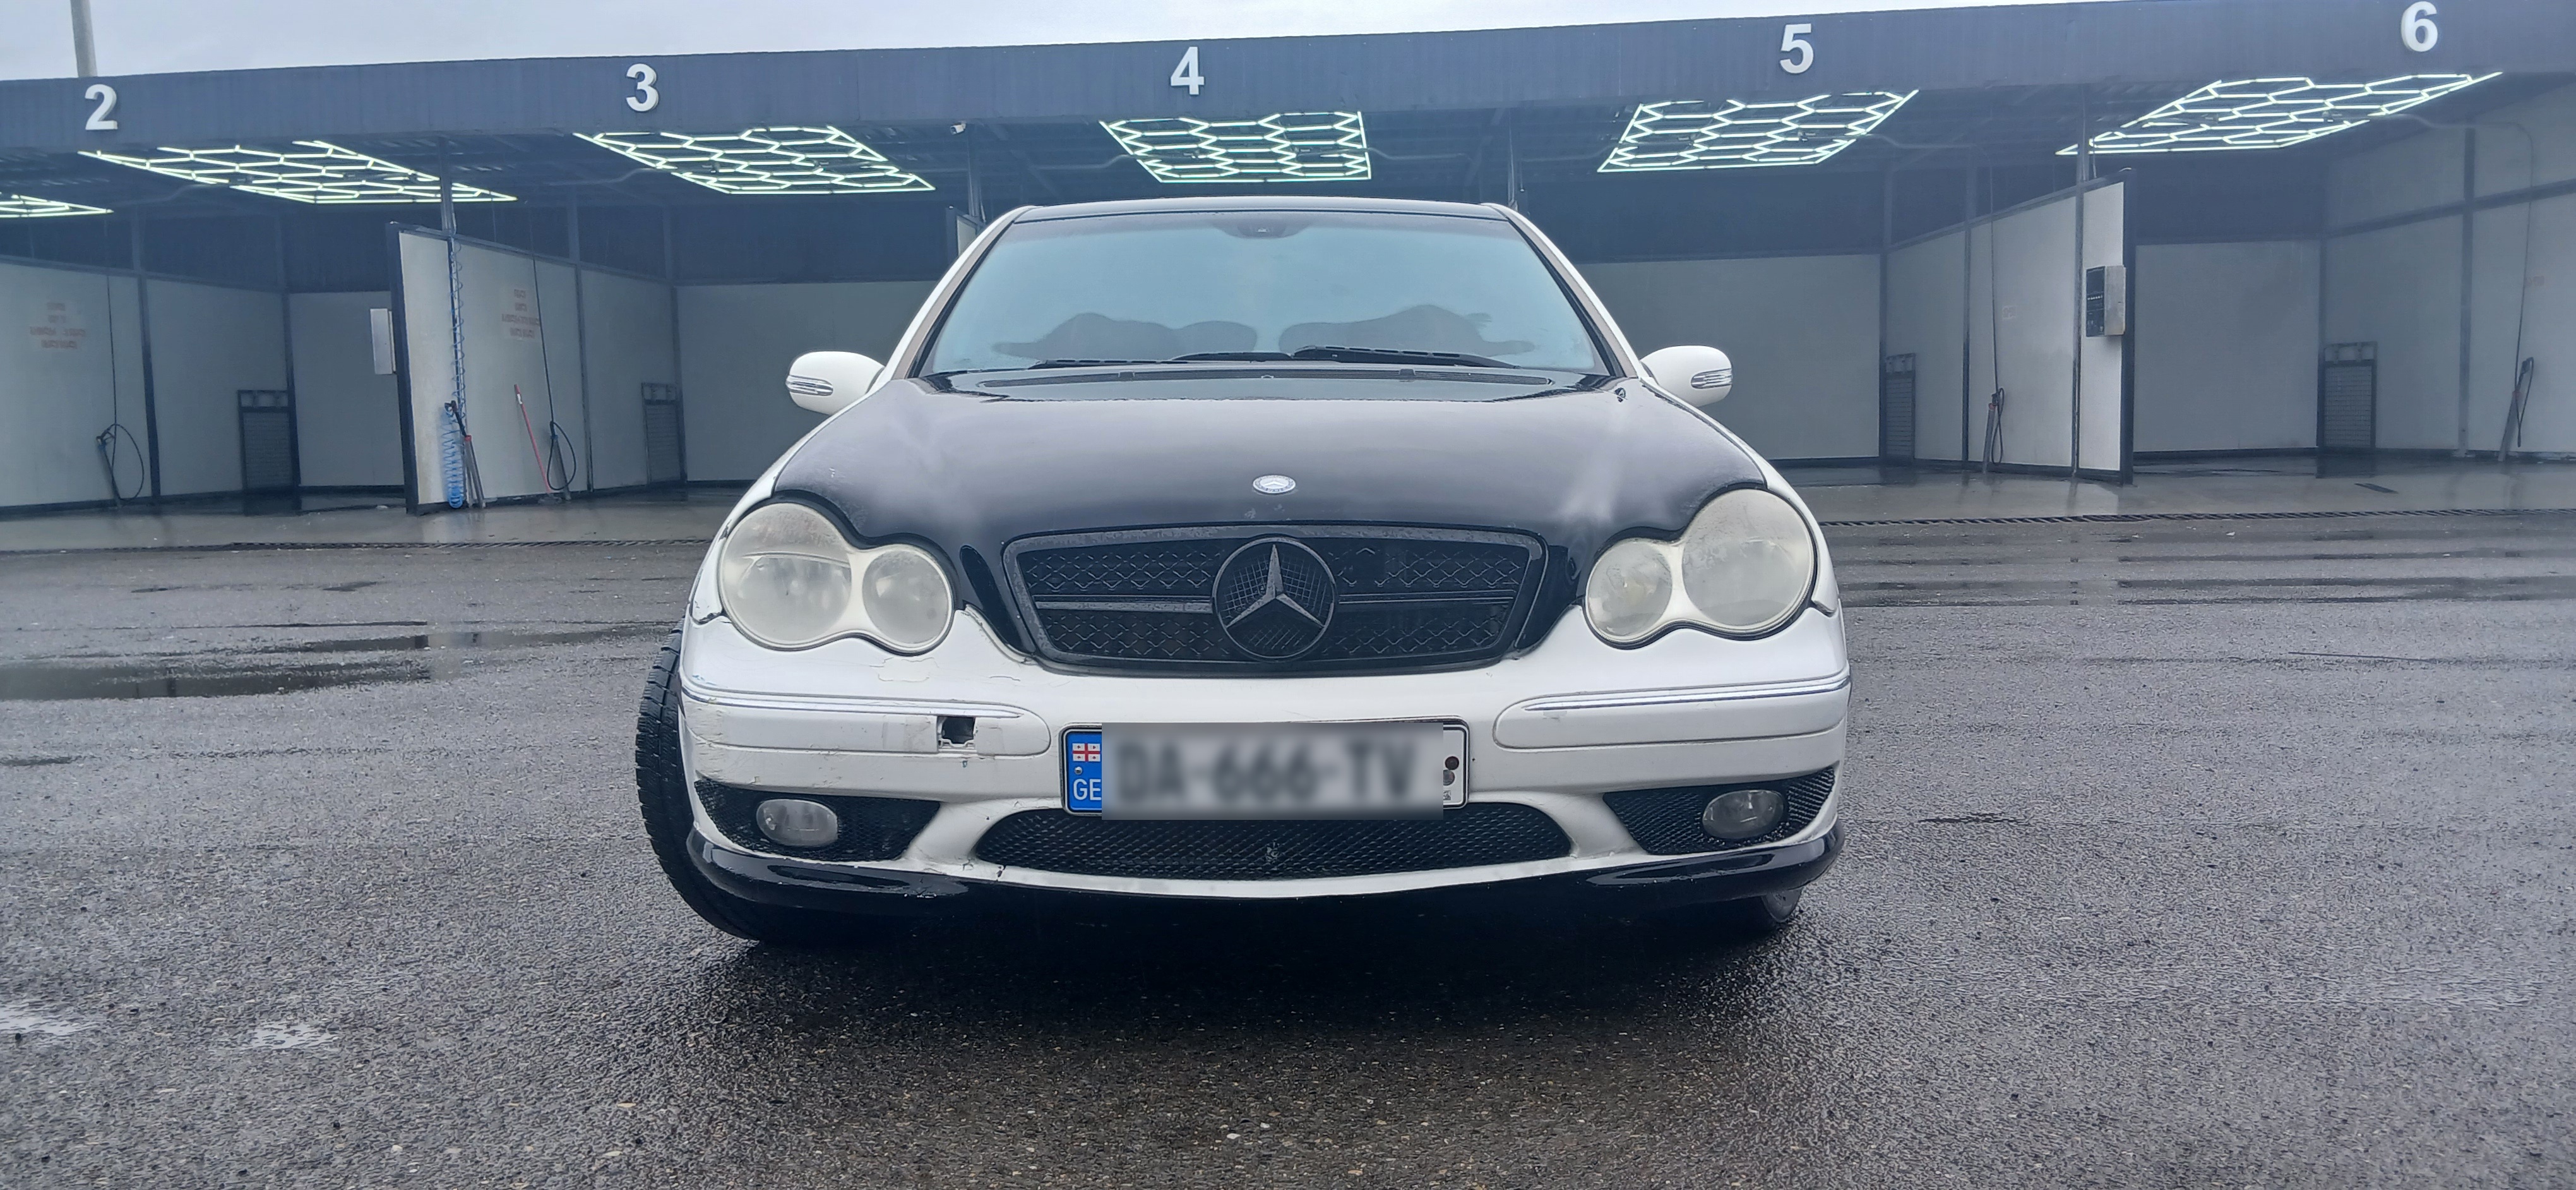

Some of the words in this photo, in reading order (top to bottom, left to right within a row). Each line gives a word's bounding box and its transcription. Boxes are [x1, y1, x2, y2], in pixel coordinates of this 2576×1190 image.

[1780, 23, 1814, 74] 5
[2400, 1, 2438, 52] 6
[626, 63, 659, 112] 3
[1171, 46, 1205, 95] 4
[85, 83, 118, 130] 2
[1073, 778, 1102, 800] GE
